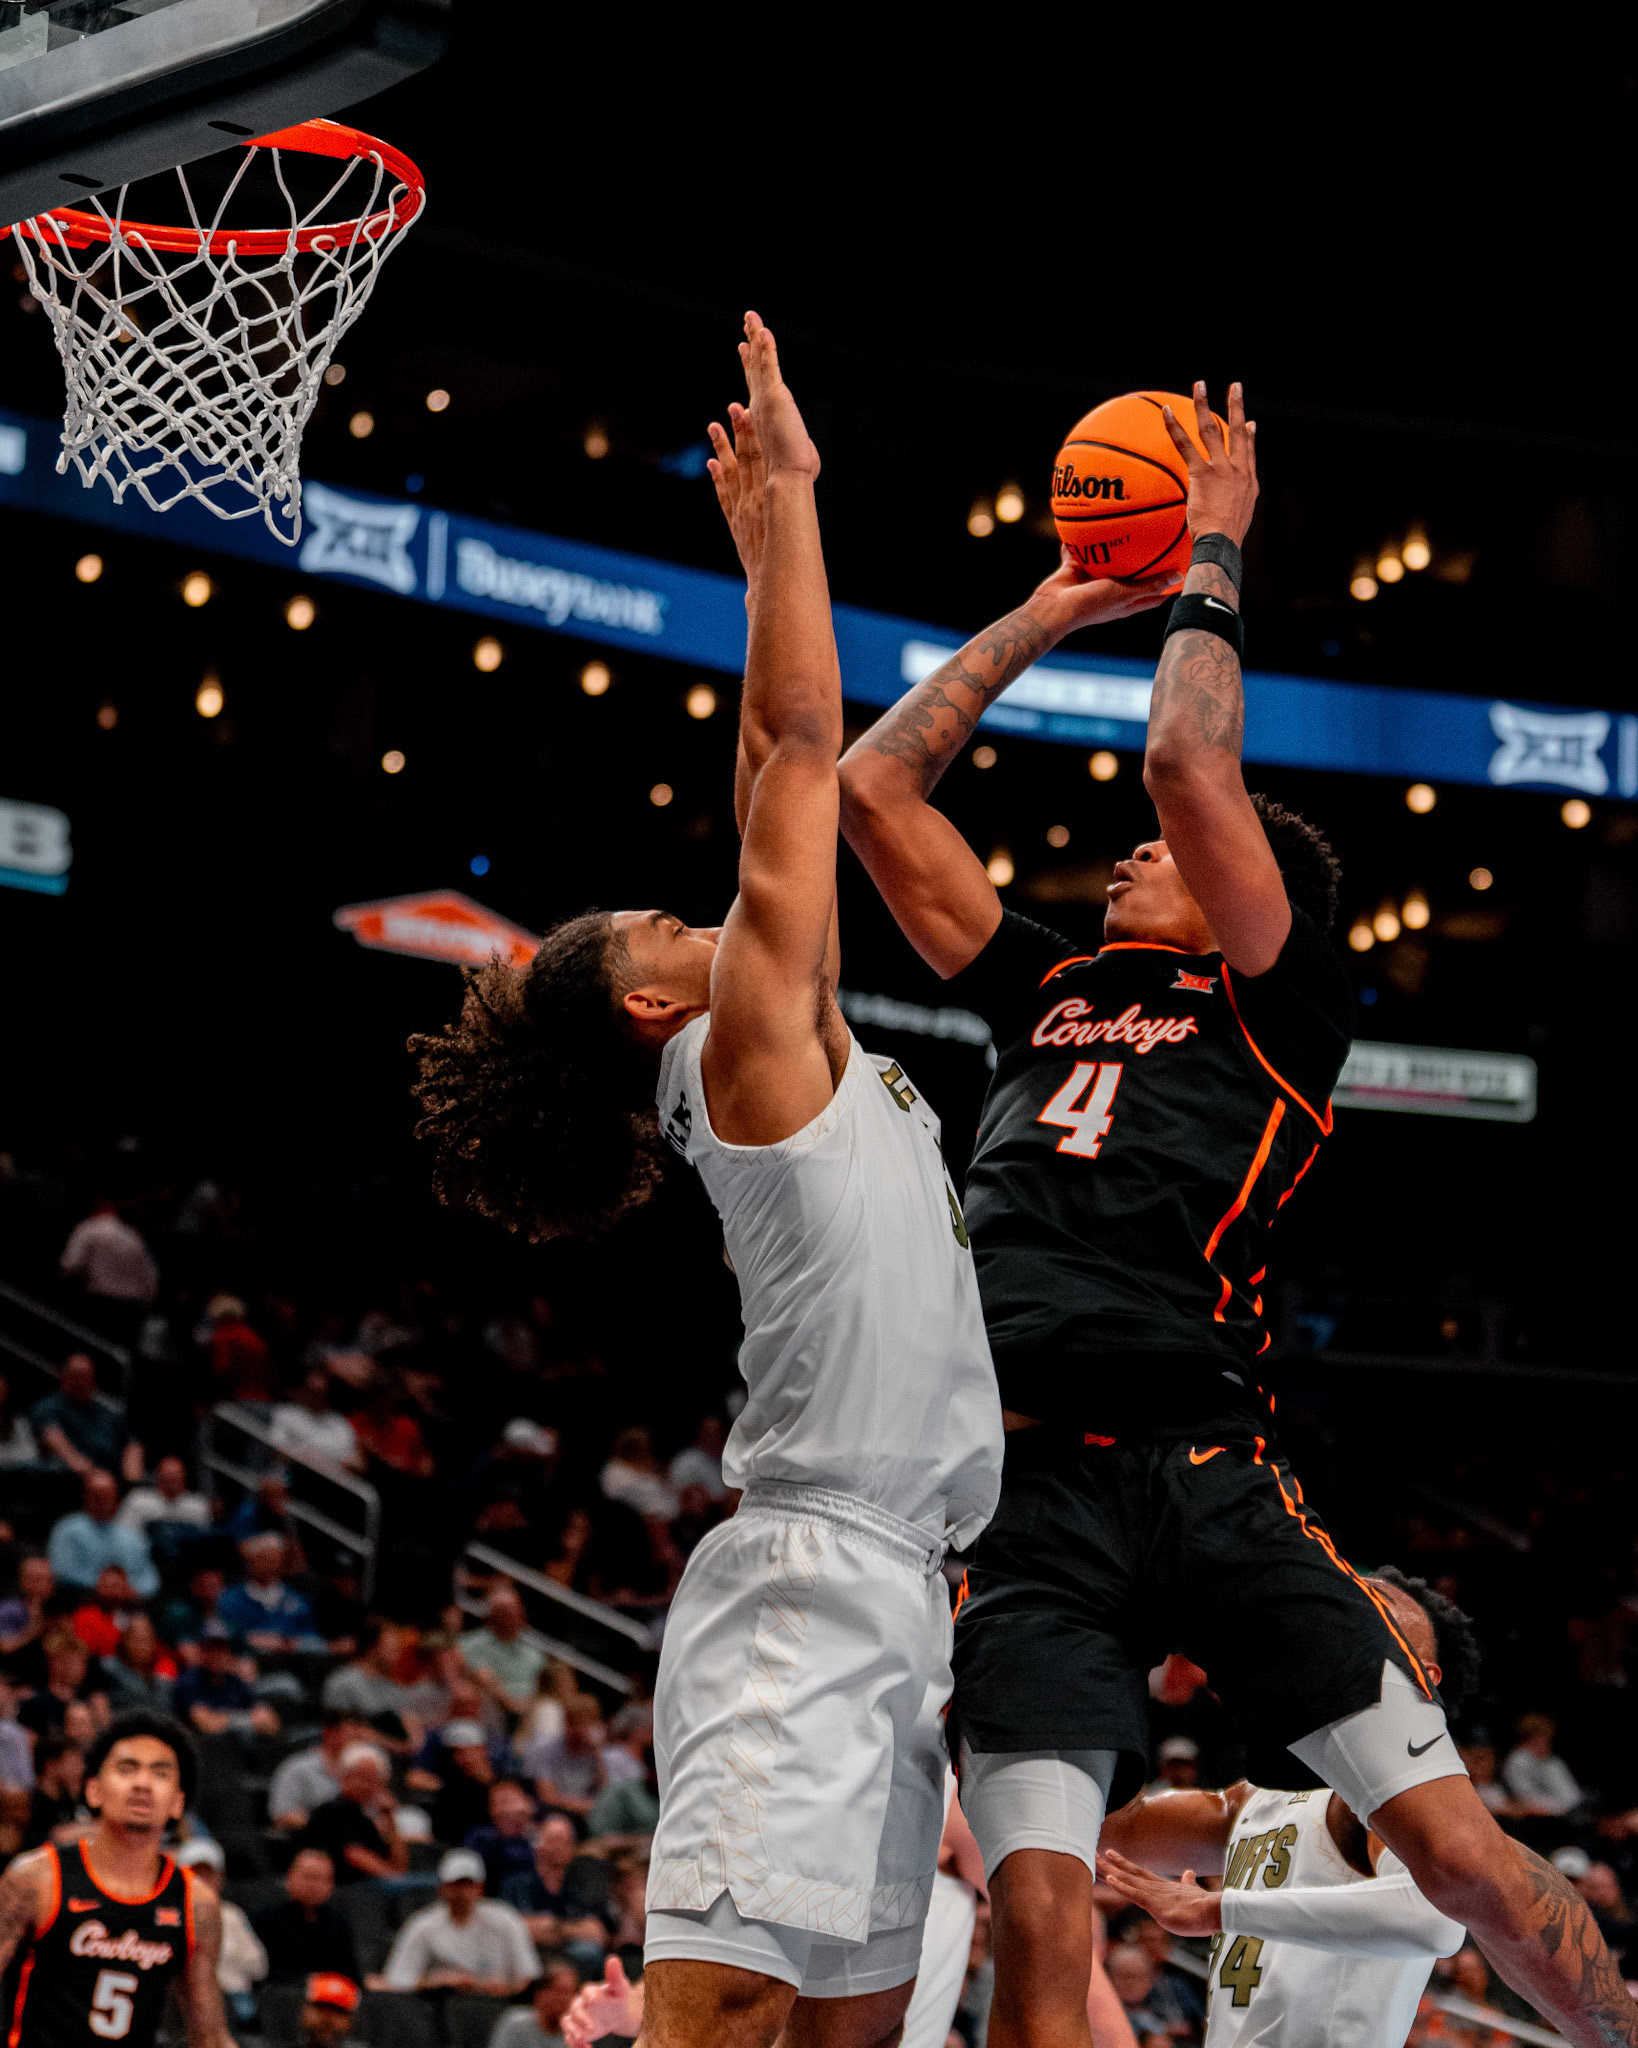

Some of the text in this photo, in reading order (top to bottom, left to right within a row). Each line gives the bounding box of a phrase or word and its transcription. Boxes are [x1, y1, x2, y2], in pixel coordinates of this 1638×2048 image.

[1053, 463, 1124, 500] ilson
[1031, 997, 1199, 1055] Cowboys
[1036, 1061, 1124, 1160] 4
[69, 1919, 174, 1971] Cowboys
[89, 1968, 139, 2040] 5
